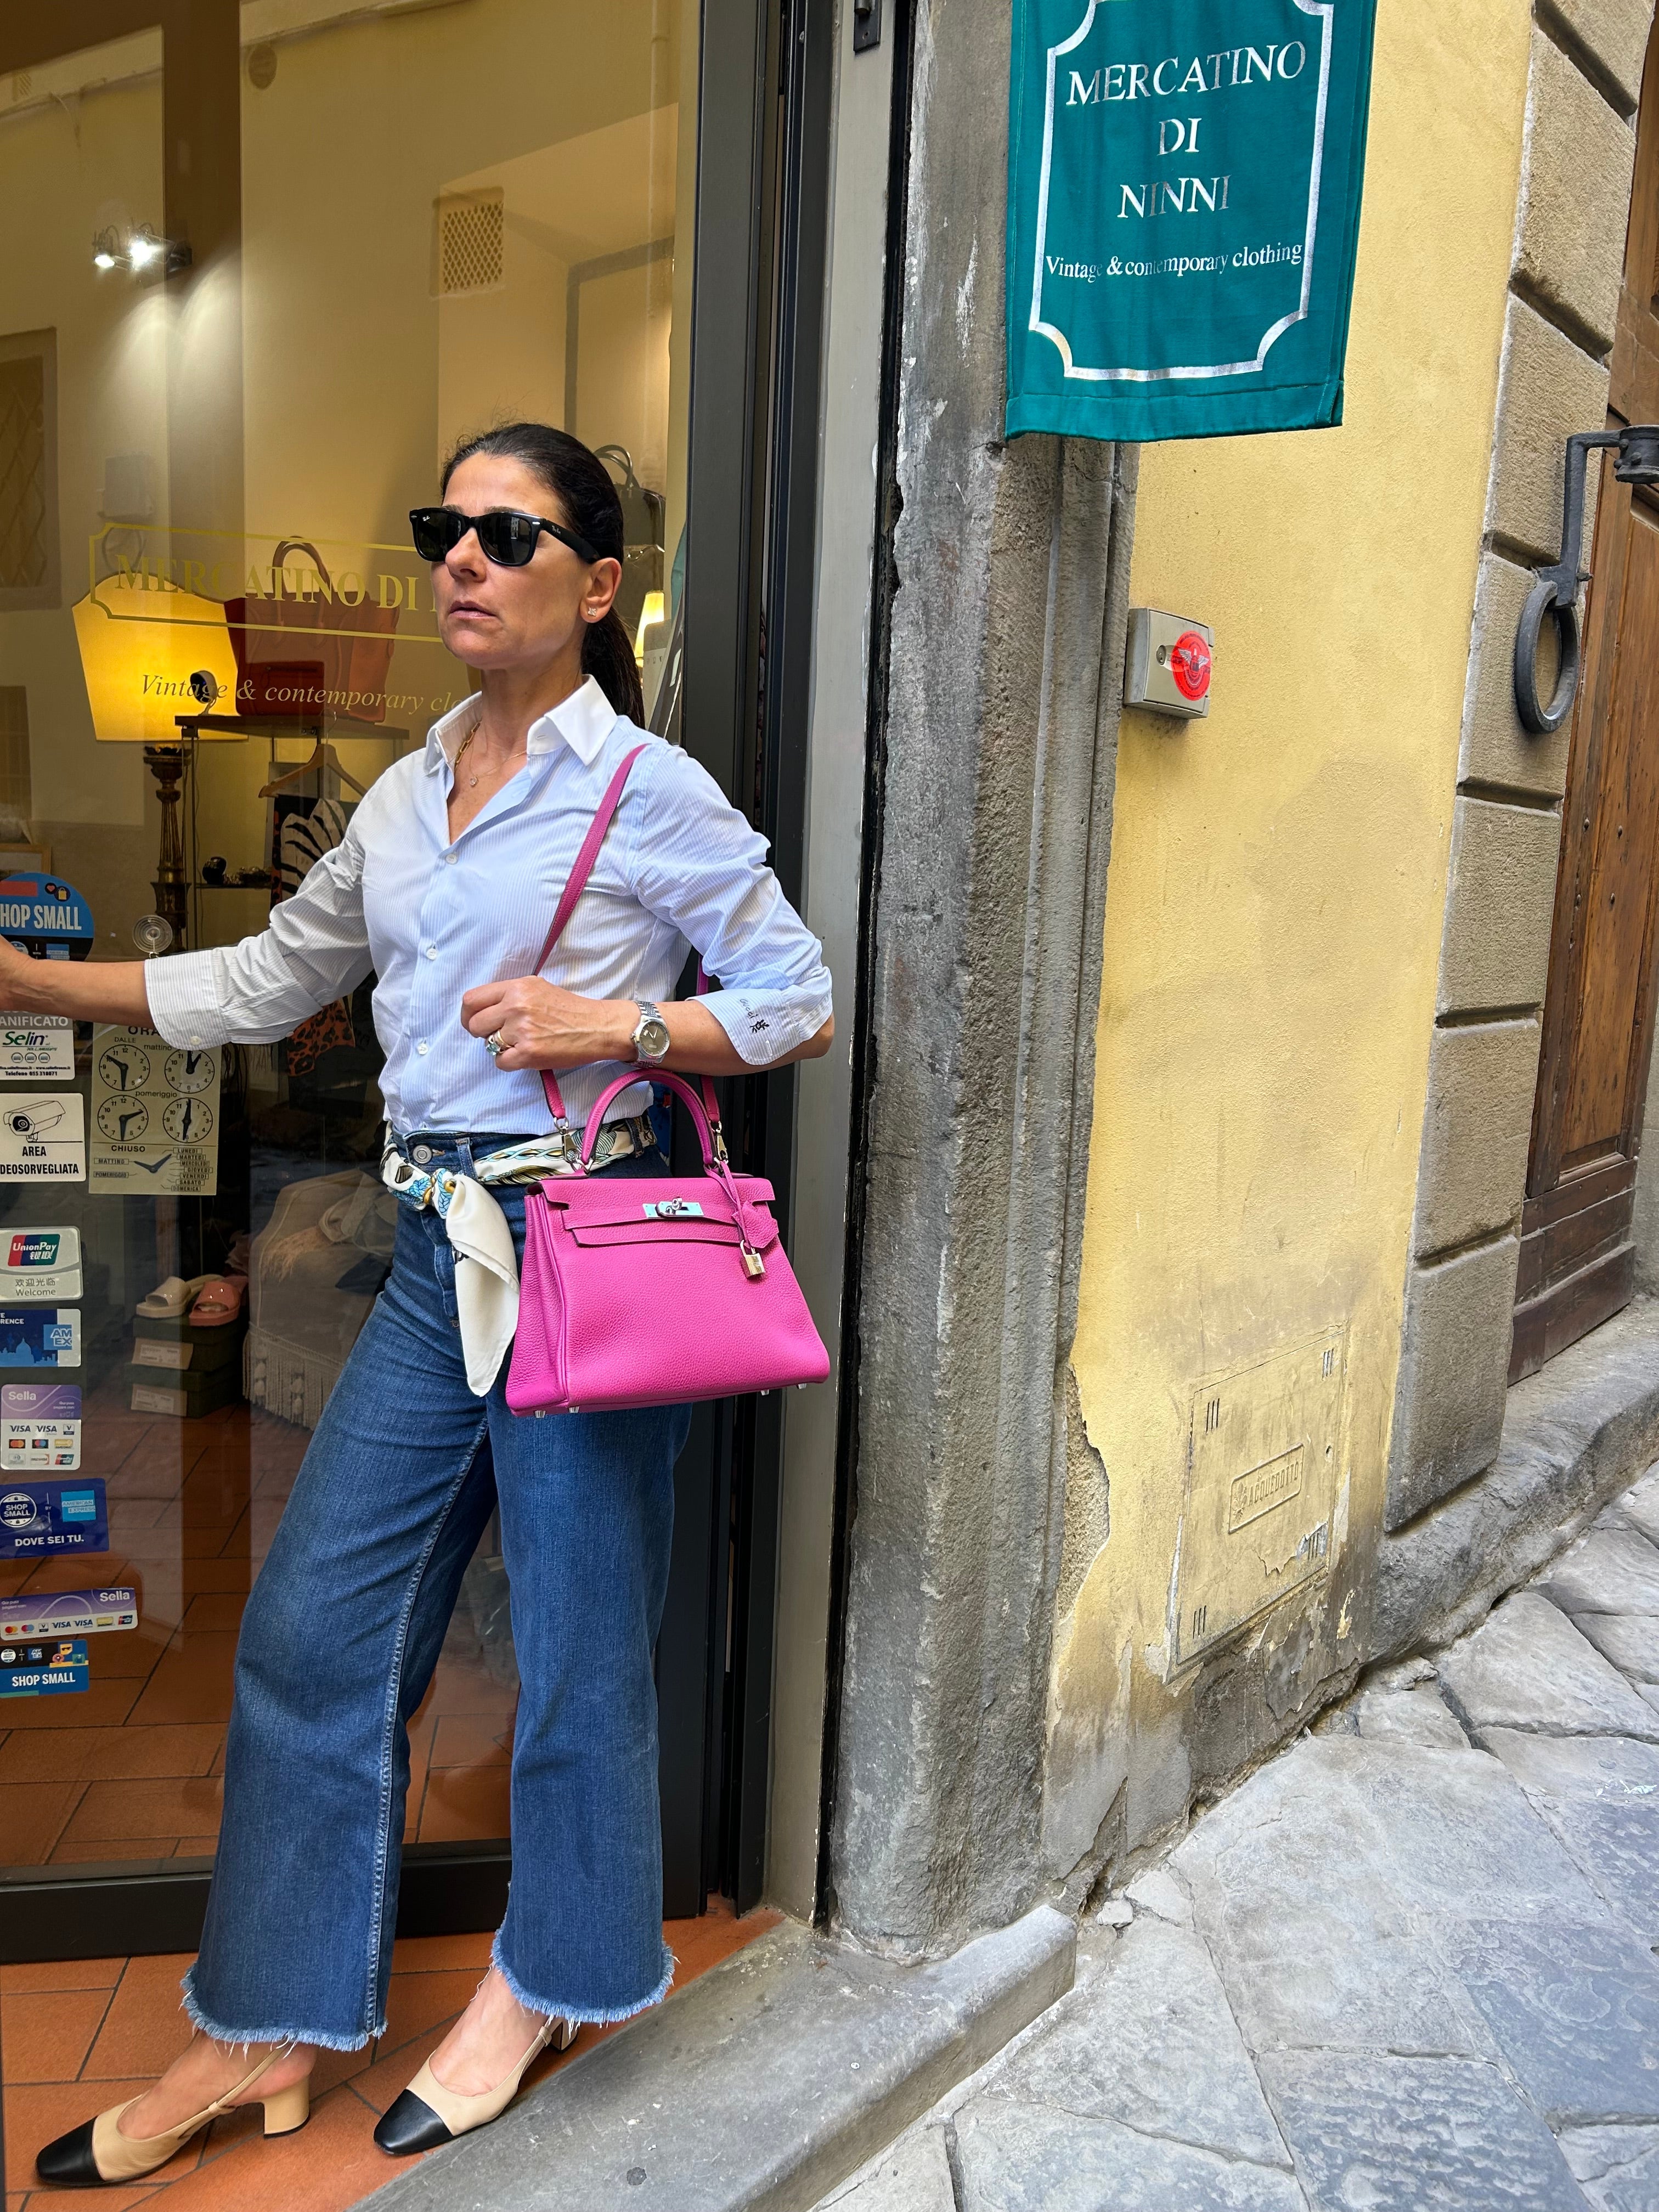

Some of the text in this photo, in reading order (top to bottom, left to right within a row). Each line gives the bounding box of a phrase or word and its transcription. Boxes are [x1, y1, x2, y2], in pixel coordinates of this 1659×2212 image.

[1066, 41, 1306, 105] MERCATINO
[1156, 117, 1202, 156] DI
[1117, 174, 1232, 218] NINNI
[1045, 241, 1303, 283] Vintage & contemporary clothing
[114, 554, 419, 611] MERCATINO DI
[142, 674, 228, 703] Vintage
[236, 679, 257, 701] &
[265, 685, 424, 715] contemporary
[33, 905, 82, 930] SMALL
[2, 1031, 45, 1046] Selin
[22, 1146, 47, 1156] AREA
[111, 1144, 145, 1153] CHIUSO
[13, 1241, 58, 1254] UnionPay
[14, 1277, 56, 1287] 欢迎光临
[15, 1288, 56, 1296] Welcome
[8, 1391, 37, 1401] Sella
[4, 1509, 31, 1517] SMALL
[15, 1534, 84, 1547] DOVE SEI TU.
[99, 1590, 130, 1602] Sella
[12, 1672, 76, 1687] SHOP SMALL
